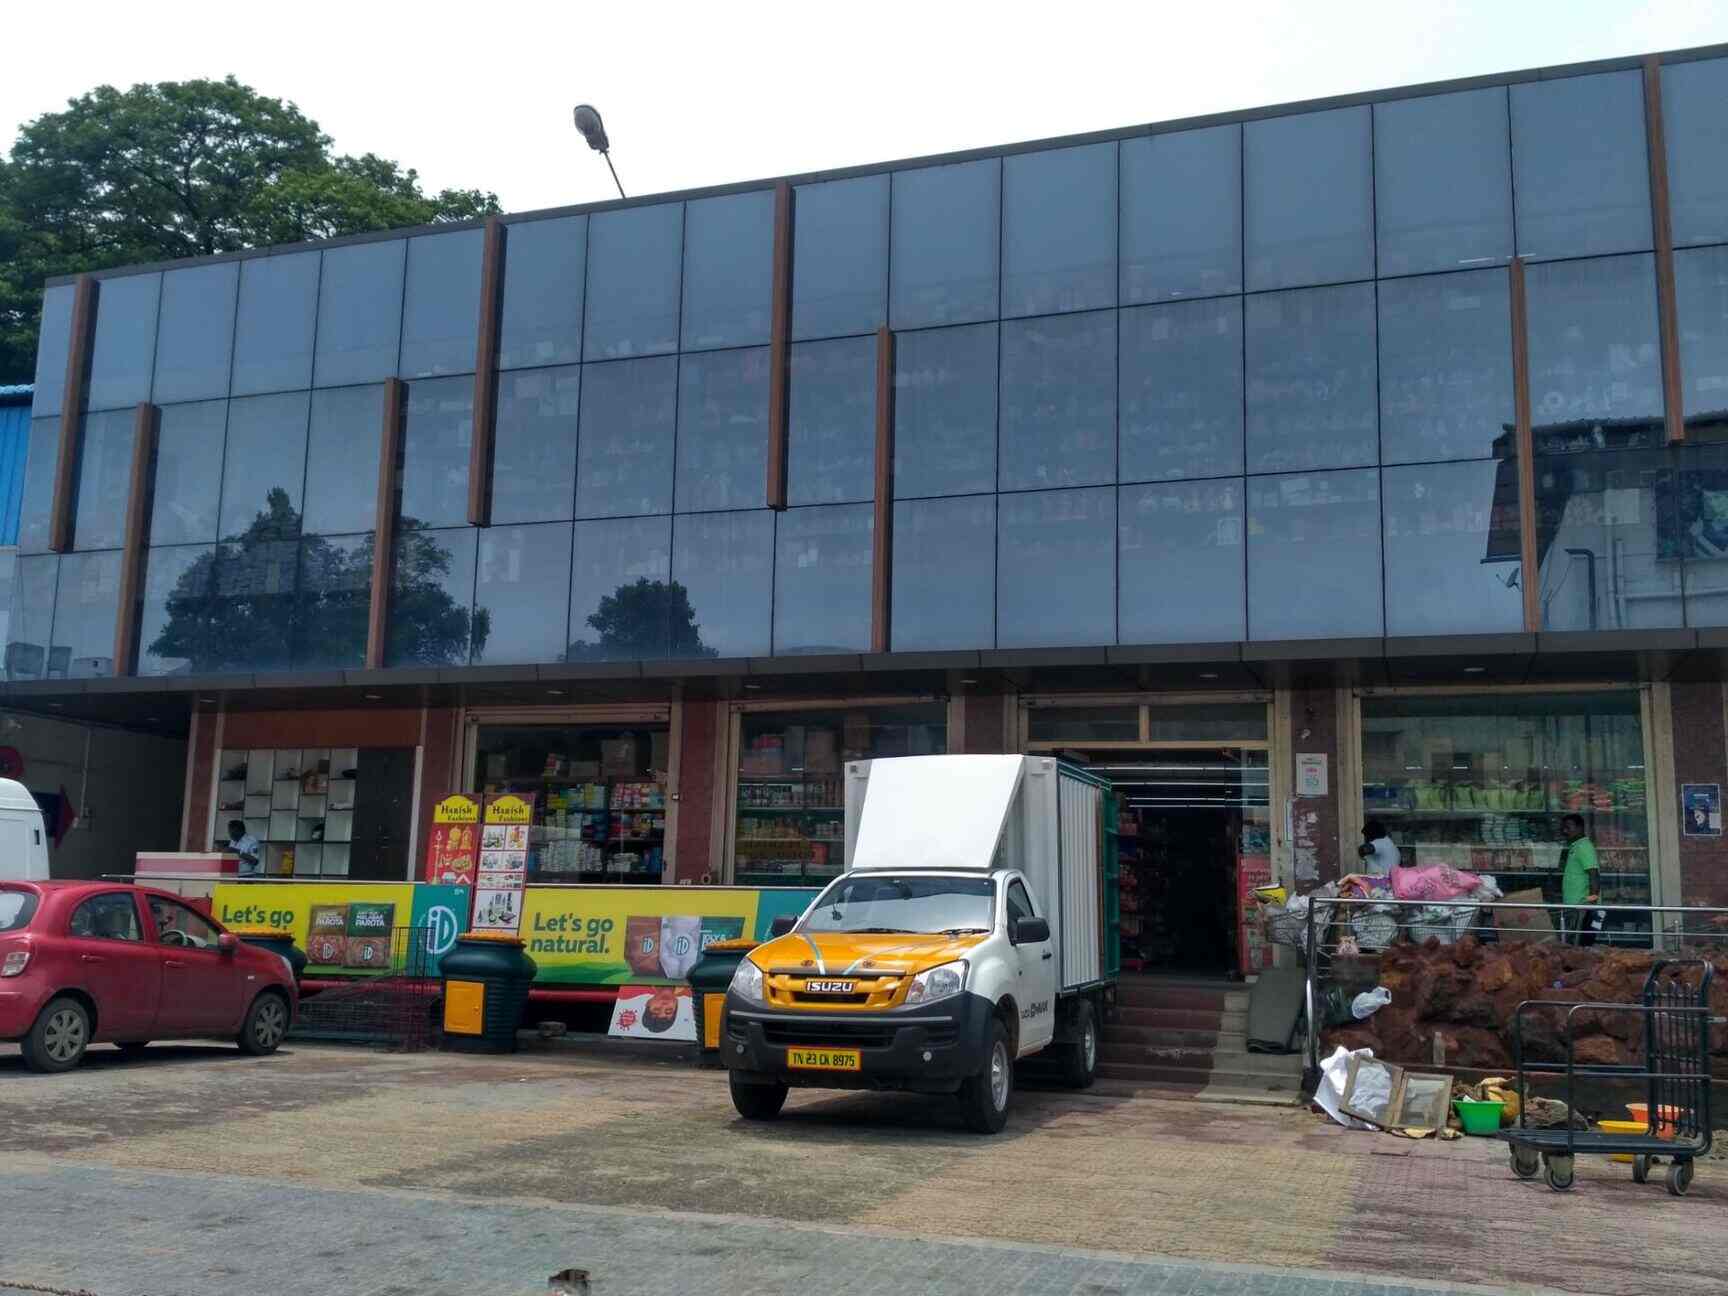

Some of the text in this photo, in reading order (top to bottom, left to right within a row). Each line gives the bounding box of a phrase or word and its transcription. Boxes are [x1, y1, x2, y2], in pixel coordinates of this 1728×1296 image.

[223, 904, 294, 928] Let's go
[534, 912, 614, 937] Let's go
[530, 934, 610, 953] natural.
[806, 981, 853, 992] ISUZU
[793, 1052, 803, 1065] TN
[832, 1054, 855, 1067] 8975
